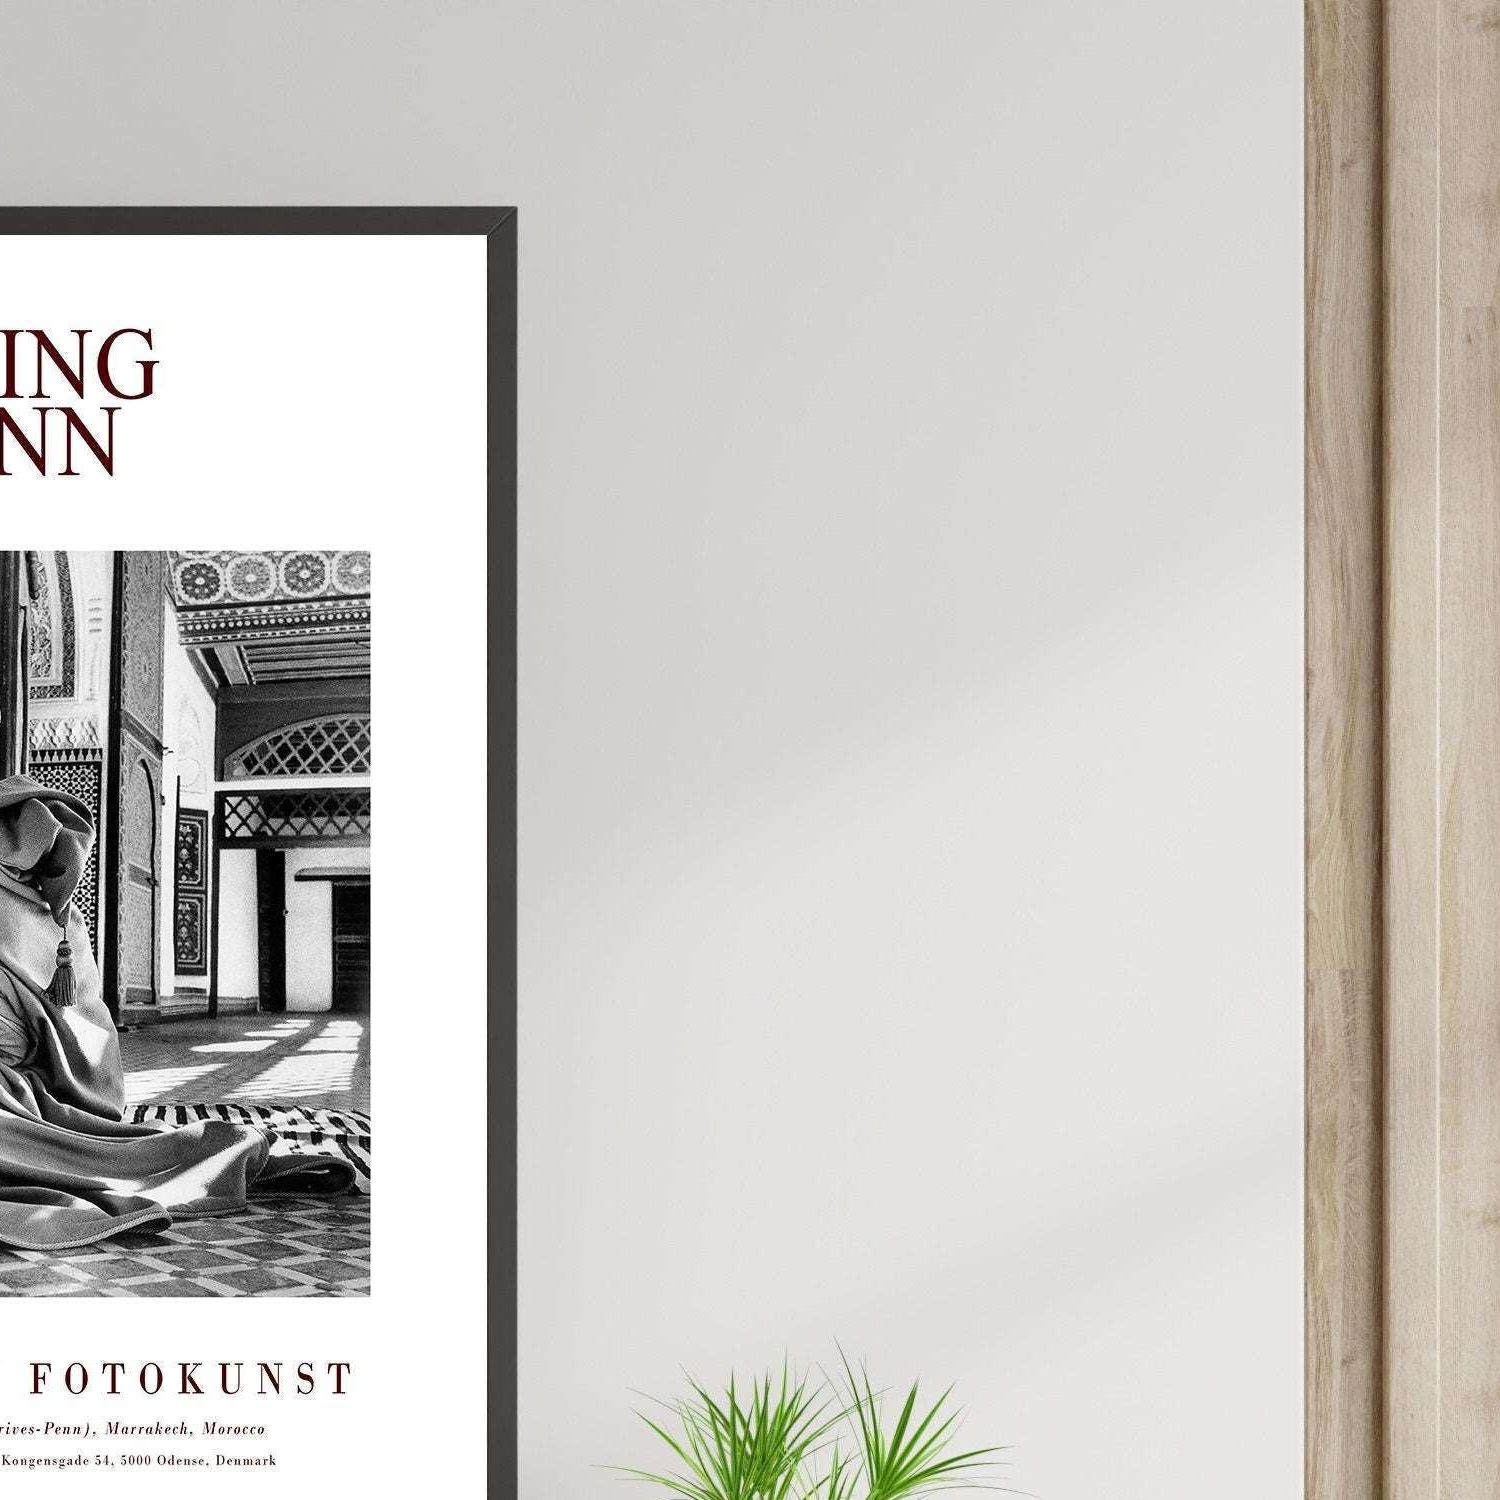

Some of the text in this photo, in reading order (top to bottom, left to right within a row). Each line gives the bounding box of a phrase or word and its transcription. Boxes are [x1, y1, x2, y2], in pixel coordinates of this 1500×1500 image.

[29, 1362, 351, 1395] FOTOKUNST
[105, 1421, 193, 1437] Marrakech,
[202, 1421, 265, 1436] Morocco
[1, 1454, 89, 1470] Kongensgade
[94, 1454, 115, 1467] 54,
[120, 1454, 151, 1467] 5000
[156, 1454, 210, 1467] Odense,
[215, 1454, 277, 1466] Denmark
